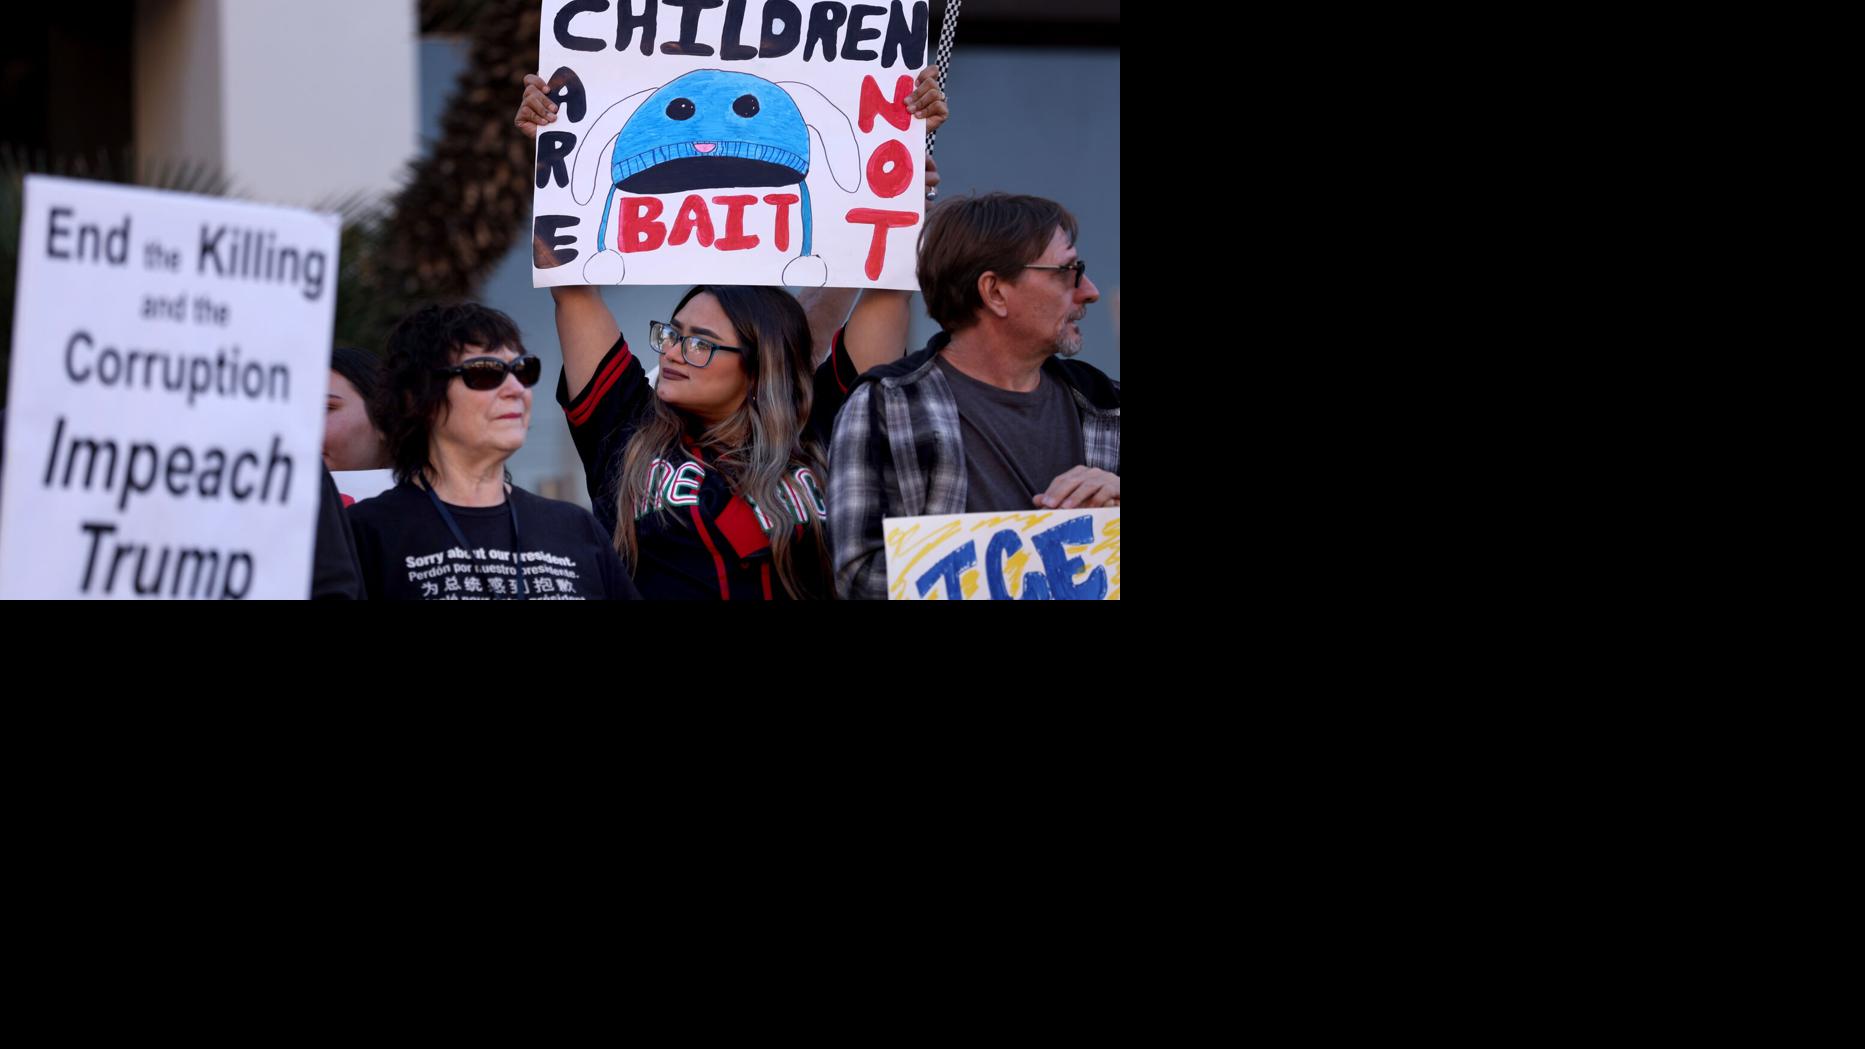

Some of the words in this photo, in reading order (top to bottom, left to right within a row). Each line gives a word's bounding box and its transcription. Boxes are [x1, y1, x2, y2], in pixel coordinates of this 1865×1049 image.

[553, 0, 928, 70] CHILDREN
[534, 66, 586, 269] ARE
[845, 74, 919, 281] NOT
[46, 207, 131, 266] End
[144, 242, 180, 272] the
[197, 222, 326, 301] Killing
[618, 194, 799, 253] BAIT
[141, 293, 186, 323] and
[192, 296, 230, 326] the
[65, 330, 290, 407] Corruption
[42, 416, 295, 513] Impeach
[78, 521, 255, 600] Trump
[405, 552, 444, 568] Sorry
[488, 549, 511, 561] our
[408, 564, 451, 582] Perdón
[453, 563, 472, 574] por
